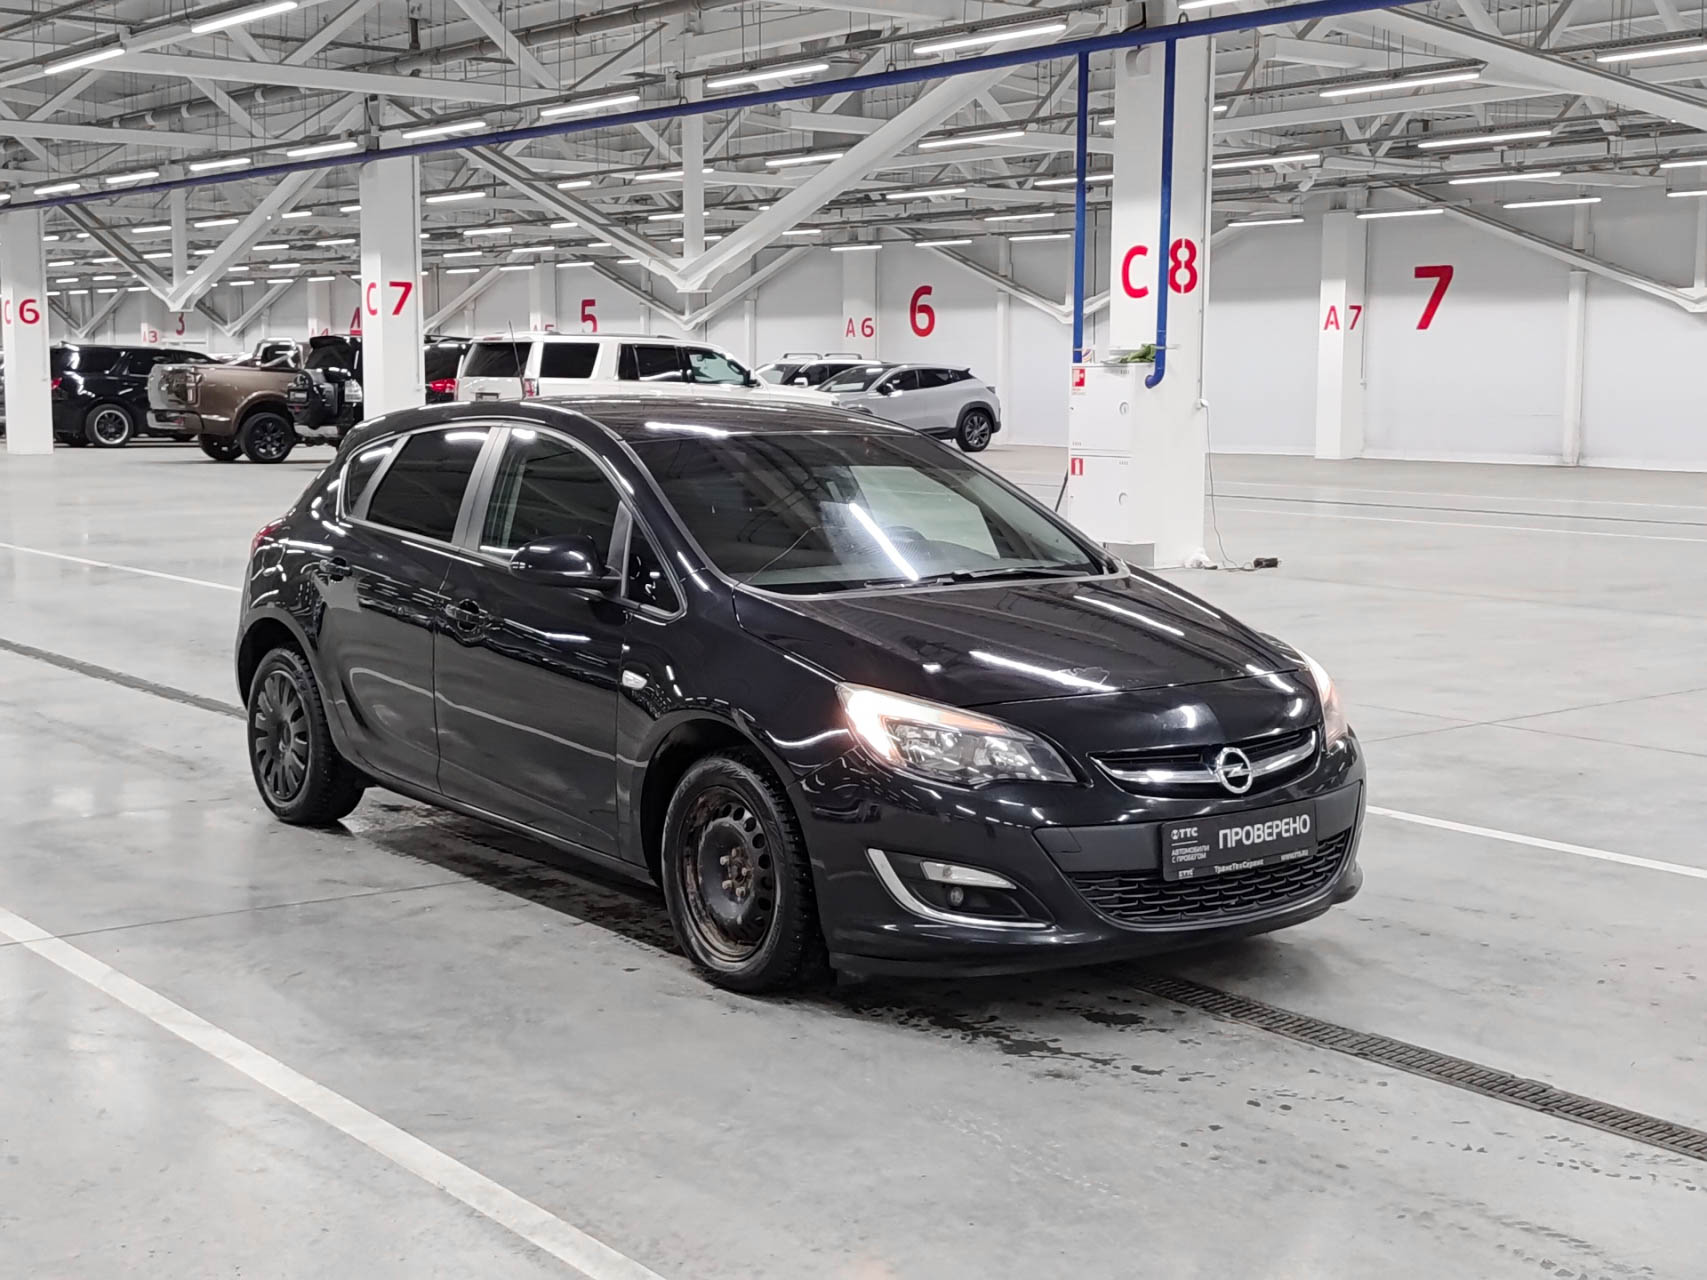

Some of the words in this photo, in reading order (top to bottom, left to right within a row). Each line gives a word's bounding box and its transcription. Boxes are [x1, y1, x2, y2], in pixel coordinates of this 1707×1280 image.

[1121, 245, 1149, 299] C
[1168, 237, 1198, 294] 8
[19, 298, 40, 325] 6
[366, 282, 378, 316] C
[389, 281, 413, 316] 7
[909, 285, 936, 337] 6
[1414, 264, 1454, 330] 7
[581, 298, 598, 334] 5
[845, 316, 857, 338] A
[860, 316, 875, 338] 6
[1323, 304, 1341, 331] A
[1348, 304, 1363, 331] 7
[148, 330, 158, 344] 3
[1219, 814, 1310, 849] ПРОВЕРЕНО
